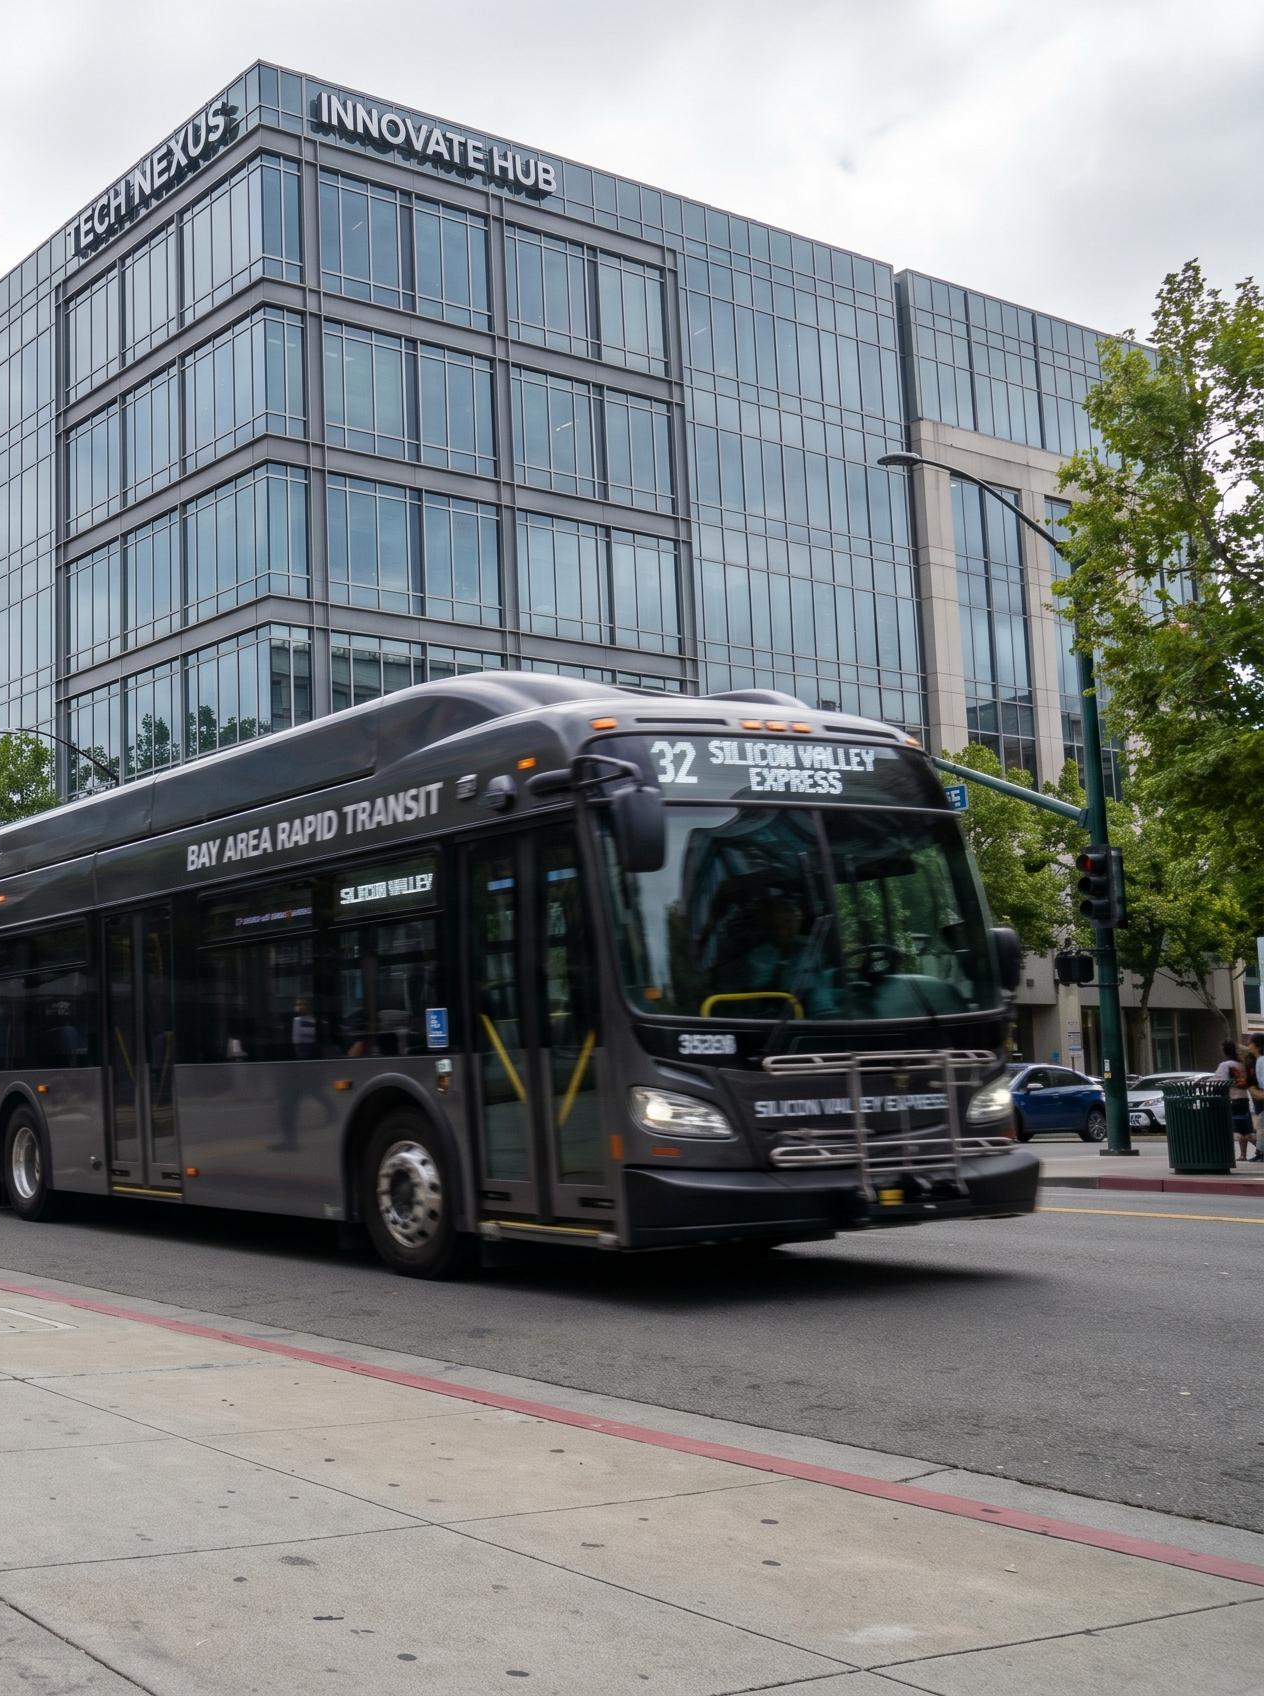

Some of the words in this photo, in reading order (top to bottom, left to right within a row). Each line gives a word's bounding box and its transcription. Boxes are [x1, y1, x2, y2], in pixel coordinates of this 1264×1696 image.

[318, 92, 486, 171] INNOVATE
[490, 146, 557, 193] HUB
[66, 178, 126, 255] TECH
[134, 100, 226, 205] NEXUS
[650, 741, 698, 784] 32
[708, 740, 797, 768] SILICON
[797, 745, 876, 772] VALLEY
[748, 767, 844, 795] EXPRESS
[186, 838, 222, 871] BAY
[223, 826, 273, 863] AREA
[276, 810, 338, 850] RAPID
[342, 782, 444, 835] TRANSIT
